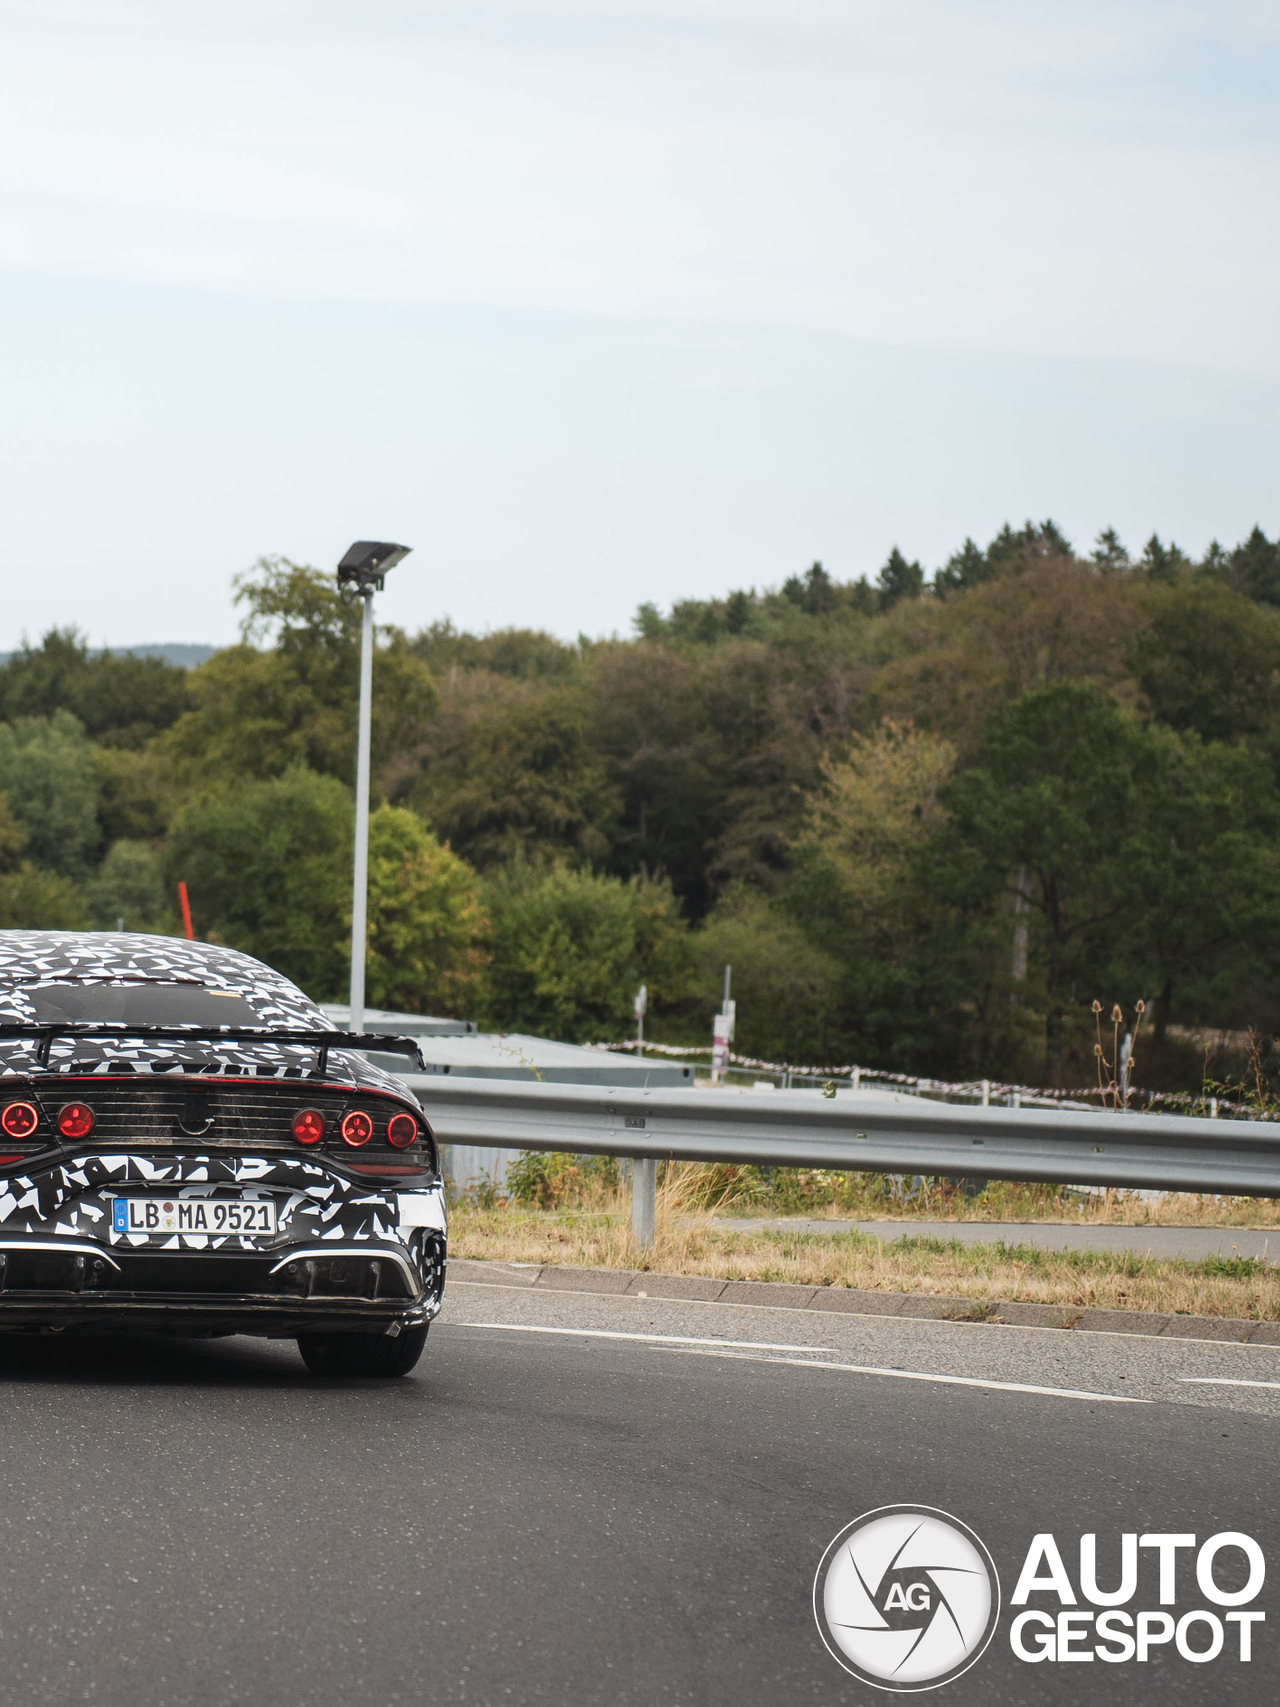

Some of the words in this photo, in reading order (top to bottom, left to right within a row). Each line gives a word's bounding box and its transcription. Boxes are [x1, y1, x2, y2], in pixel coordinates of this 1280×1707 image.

[118, 1219, 125, 1227] D
[130, 1203, 160, 1229] LB
[178, 1204, 208, 1229] MA
[214, 1204, 271, 1231] 9521
